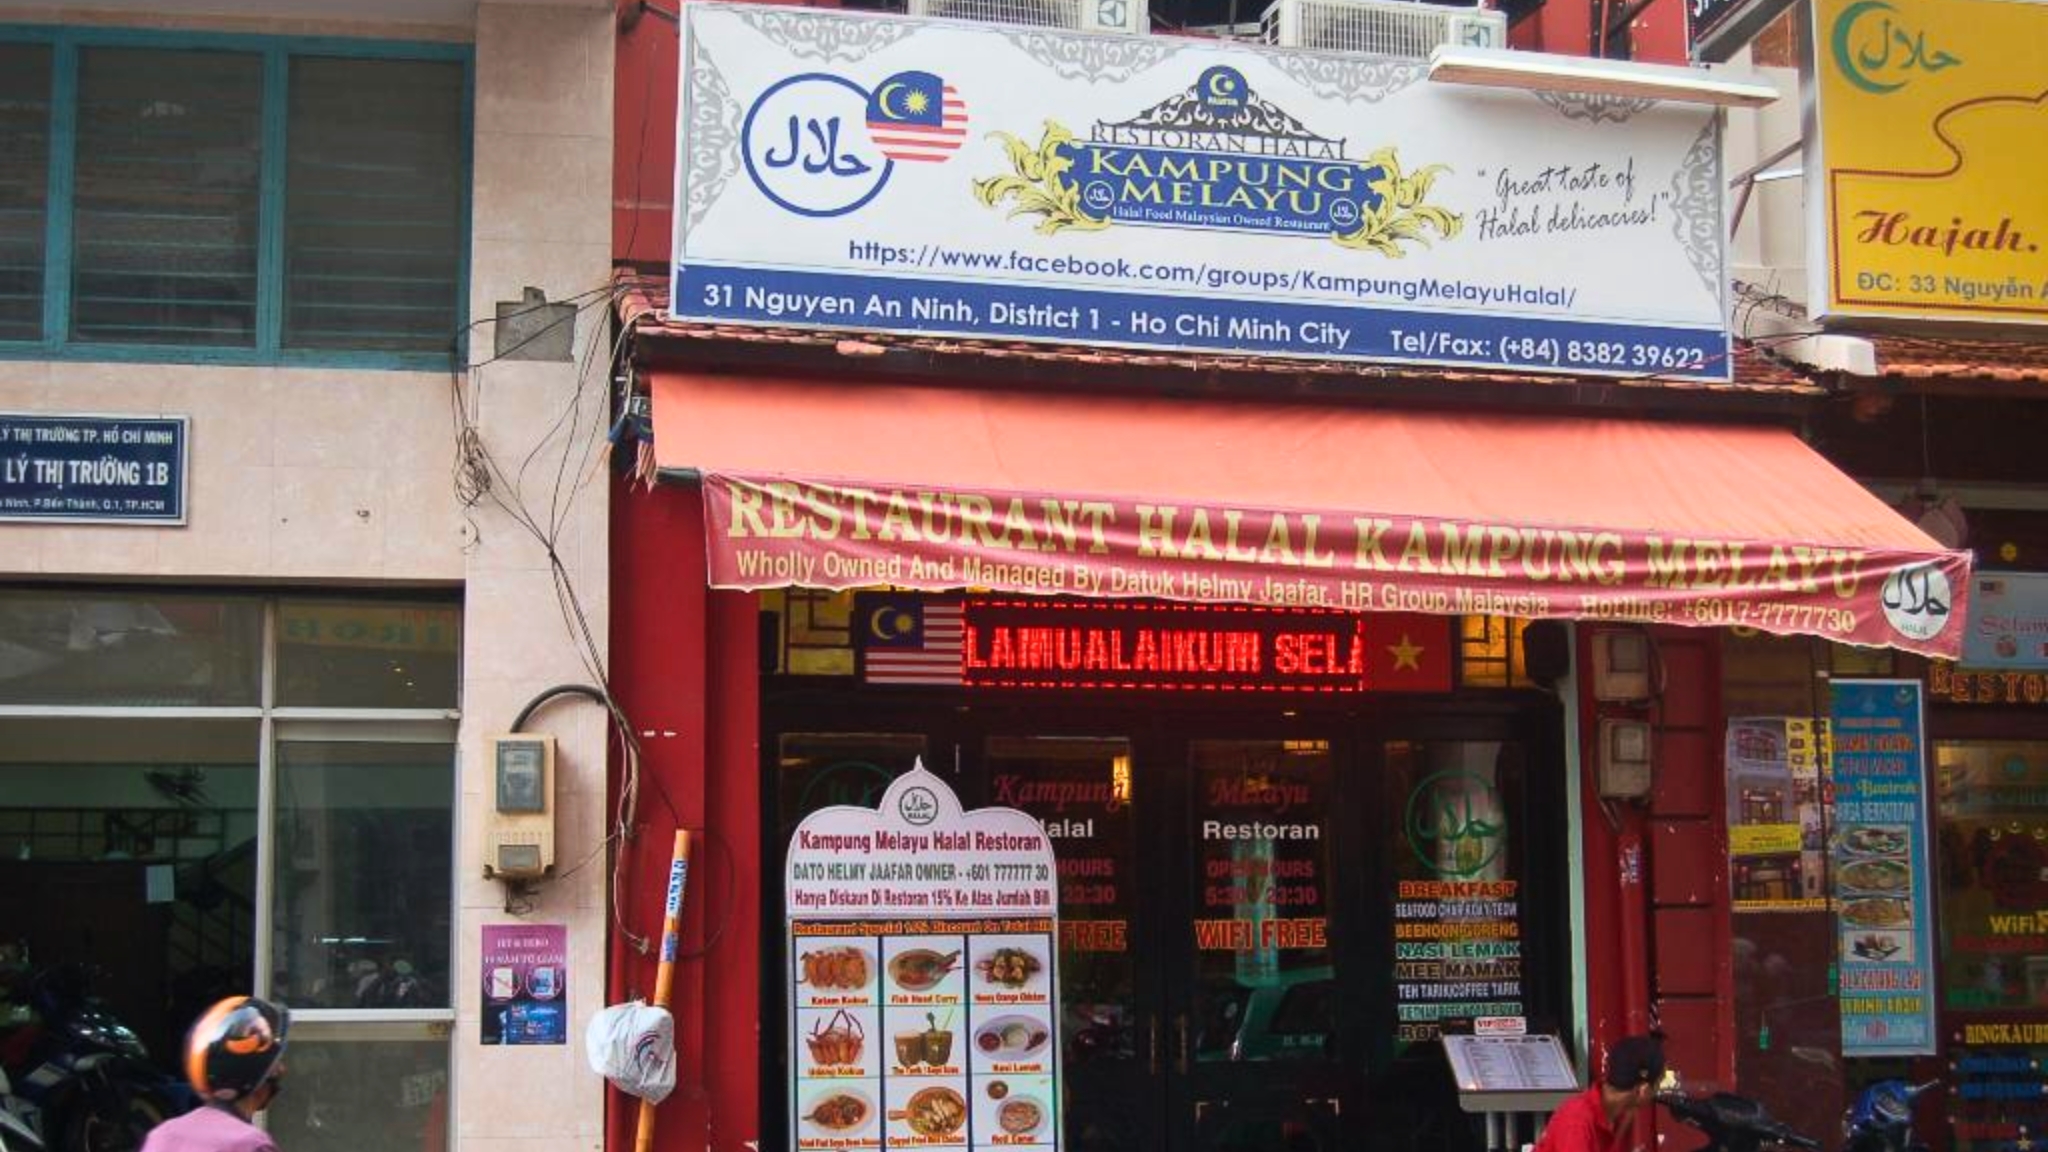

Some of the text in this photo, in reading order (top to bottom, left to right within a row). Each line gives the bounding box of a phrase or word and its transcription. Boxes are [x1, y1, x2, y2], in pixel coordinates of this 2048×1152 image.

[764, 114, 872, 177] حلال
[1090, 149, 1355, 192] KAMPUNG
[1121, 178, 1321, 215] MELAYU
[1496, 167, 1554, 213] Great
[1554, 162, 1609, 190] taste
[1615, 156, 1635, 206] of
[1113, 206, 1143, 219] Halal
[1145, 209, 1173, 222] Food
[1175, 210, 1231, 227] Malaysian
[1233, 214, 1272, 227] Owned
[1475, 204, 1540, 241] Halal
[849, 239, 1577, 309] https://www.facebook.com/groups/KampungMelayuHalal/
[1857, 273, 1901, 293] ĐC:
[1909, 274, 1936, 293] 33
[703, 284, 733, 307] 31
[745, 286, 855, 317] Nguyen
[864, 294, 901, 316] An
[911, 296, 980, 324] Ninh,
[990, 302, 1079, 330] District
[1089, 308, 1099, 330] 1
[1131, 310, 1167, 334] Ho
[1175, 313, 1219, 338] Chi
[1227, 317, 1291, 342] Minh
[1300, 320, 1350, 349] City
[1391, 330, 1491, 357] Tel/Fax:
[1500, 335, 1560, 365] (+84)
[1567, 341, 1626, 366] 8382
[1631, 347, 1704, 370] 39622
[83, 429, 99, 443] TP.
[144, 430, 173, 444] MINH
[6, 453, 169, 490] LÝ THỊ TRƯỜNG 1B
[727, 485, 1864, 597] RESTAURANT HALAL KAMPUNG MELAYU
[737, 549, 815, 577] Wholly
[823, 551, 901, 579] Owned
[909, 555, 955, 580] And
[963, 556, 1065, 588] Managed
[1073, 564, 1102, 591] By
[1111, 566, 1175, 592] Datuk
[1183, 571, 1253, 599] Helmy
[1341, 581, 1373, 604] HR
[1684, 598, 1856, 632] +6017-7777730
[800, 830, 1041, 854] Kampung Melayu Halal Restoran
[1203, 820, 1319, 841] Restoran
[794, 863, 824, 880] DATO
[828, 863, 866, 880] HELMY
[870, 864, 912, 881] JAAFAR
[1035, 864, 1049, 881] 30
[795, 889, 826, 909] Hanya
[884, 890, 928, 906] Restoran
[932, 889, 952, 906] 15%
[1399, 881, 1517, 899] BREAKFAST
[1396, 903, 1437, 918] SEAFOOD
[1194, 918, 1327, 949] WIFI FREE
[1396, 940, 1521, 959] NASI LEMAK
[1396, 960, 1520, 979] MEE MAMAK
[1398, 985, 1419, 1000] TEH
